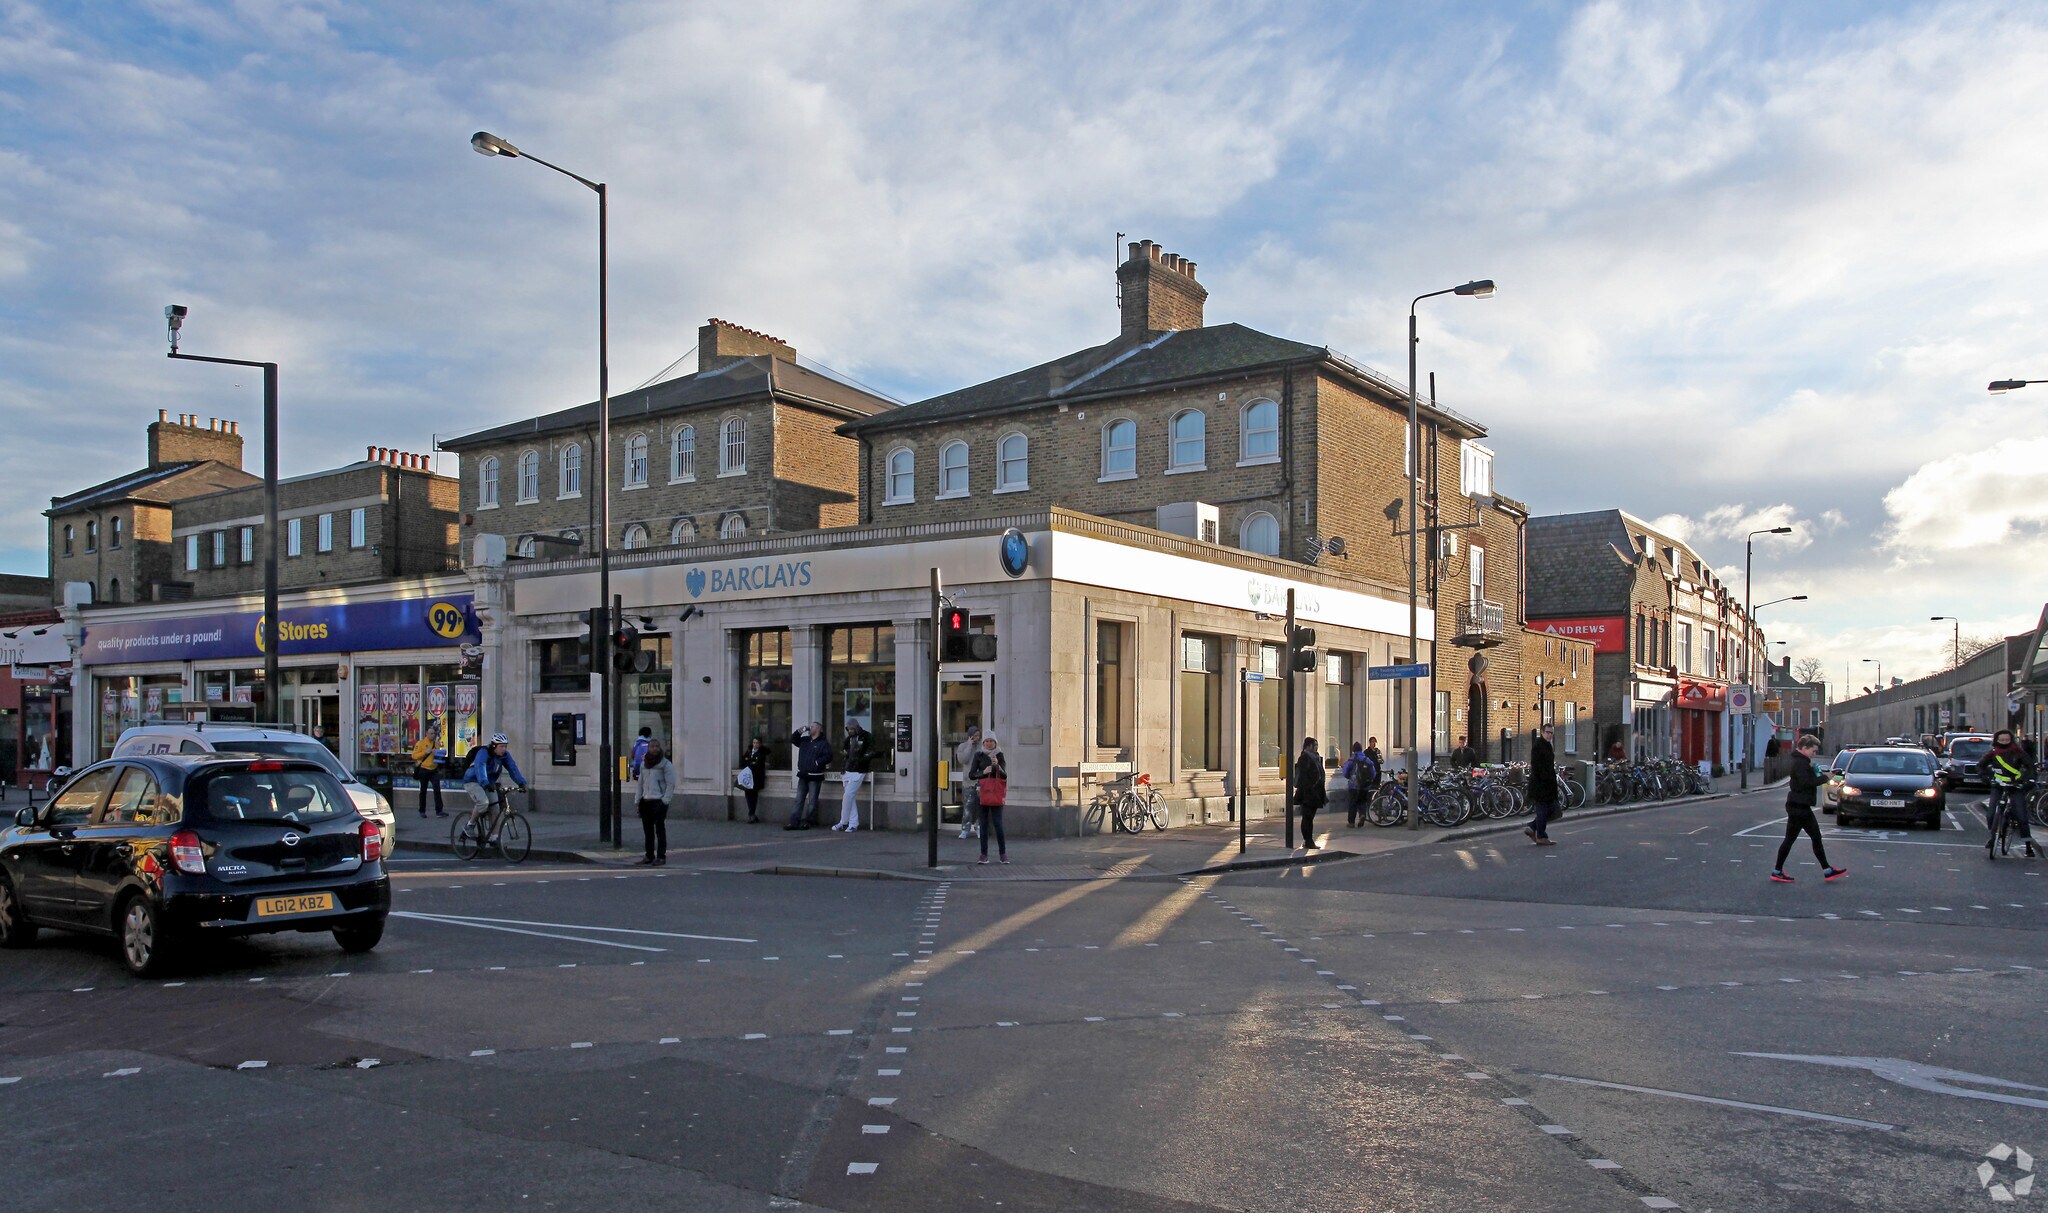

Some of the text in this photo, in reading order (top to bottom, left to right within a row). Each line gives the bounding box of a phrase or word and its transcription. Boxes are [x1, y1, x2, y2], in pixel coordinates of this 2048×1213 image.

[711, 561, 811, 592] BARCLAYS
[1264, 584, 1320, 613] BARLAYS
[279, 621, 328, 641] Stores
[434, 609, 463, 632] 99p
[98, 629, 222, 651] quality products under a pound!
[266, 897, 325, 913] LG12 KBZ
